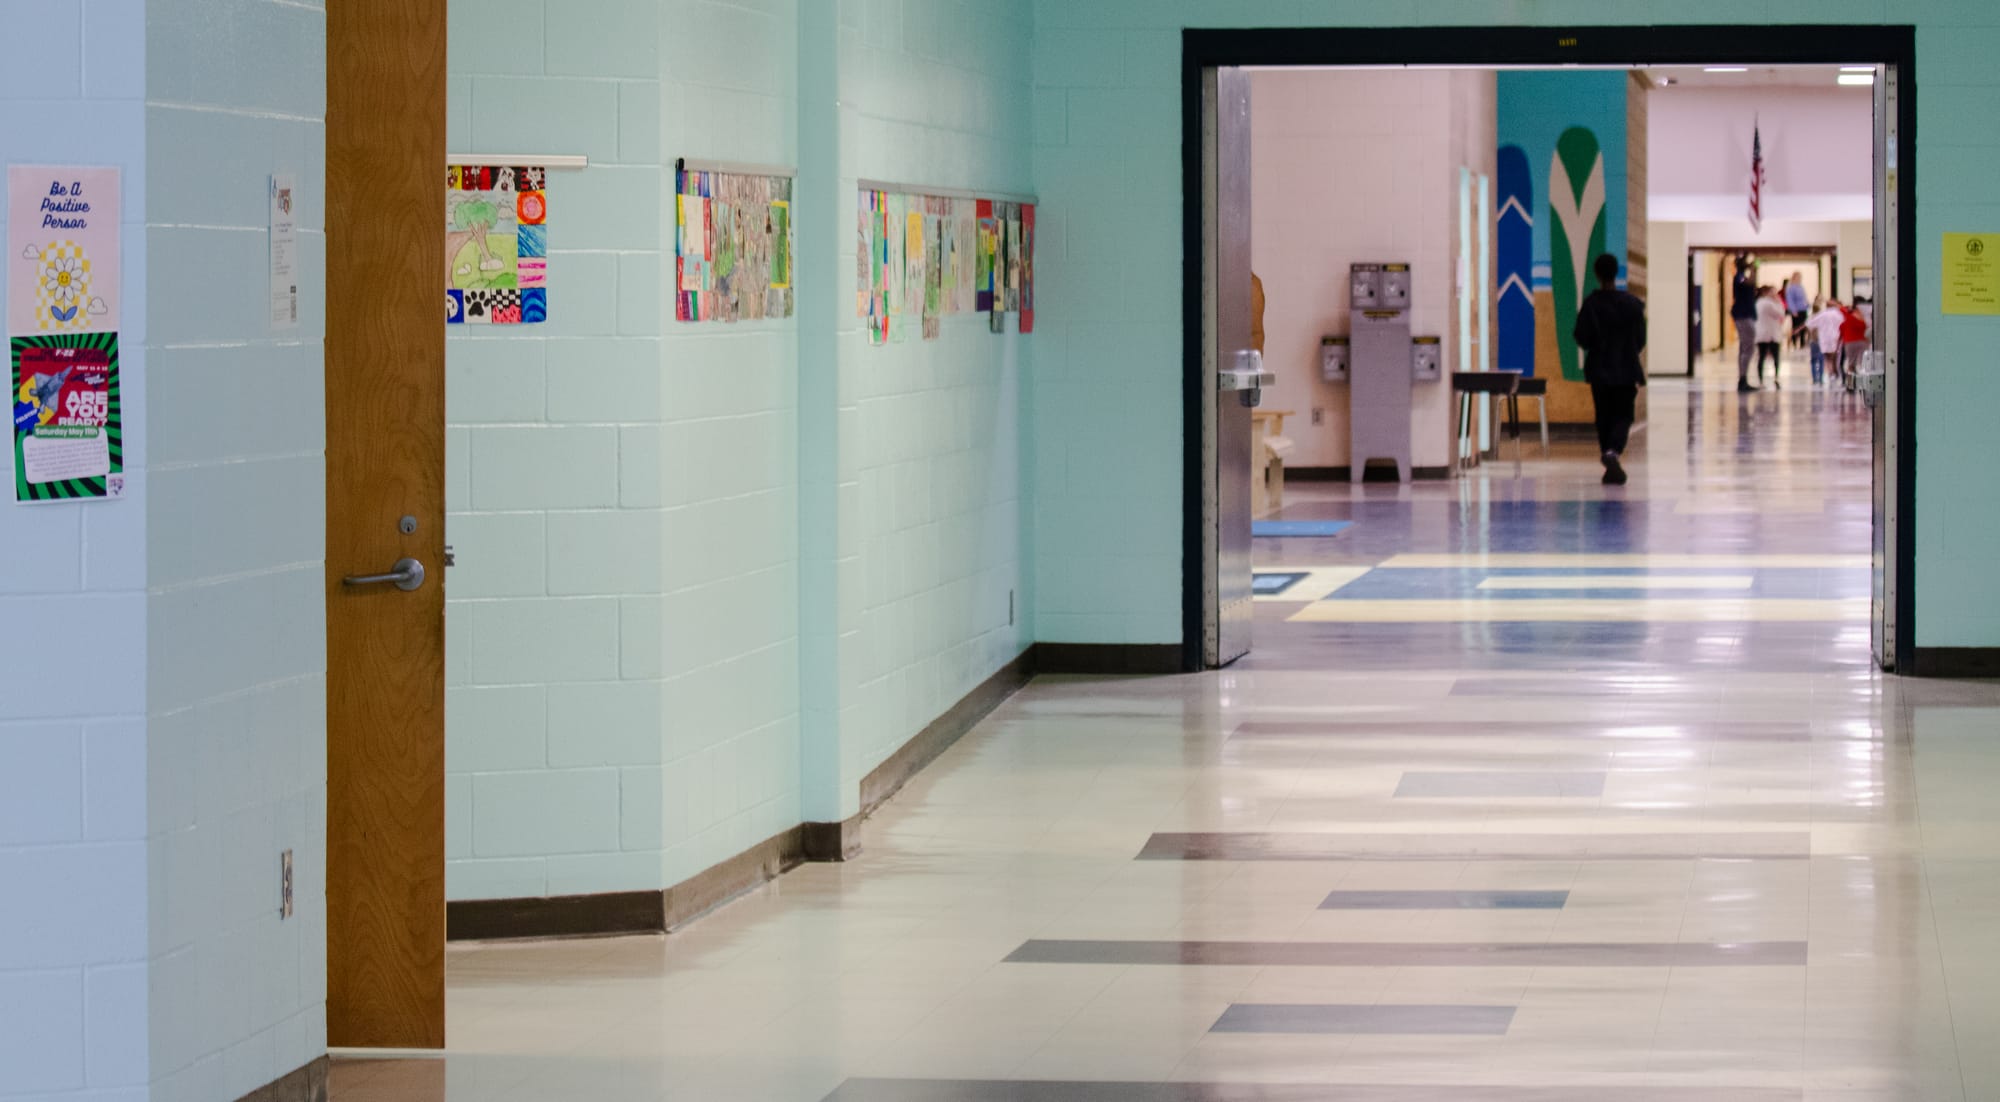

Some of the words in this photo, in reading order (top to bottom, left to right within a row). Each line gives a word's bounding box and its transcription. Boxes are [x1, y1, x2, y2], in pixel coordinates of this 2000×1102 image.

[49, 181, 68, 196] Be
[70, 182, 82, 196] A
[40, 197, 90, 213] Positive
[42, 214, 87, 229] Person
[66, 391, 108, 404] ARE
[65, 403, 108, 417] YOU
[58, 416, 108, 427] READY?
[35, 428, 68, 438] Saturday
[68, 427, 85, 437] May
